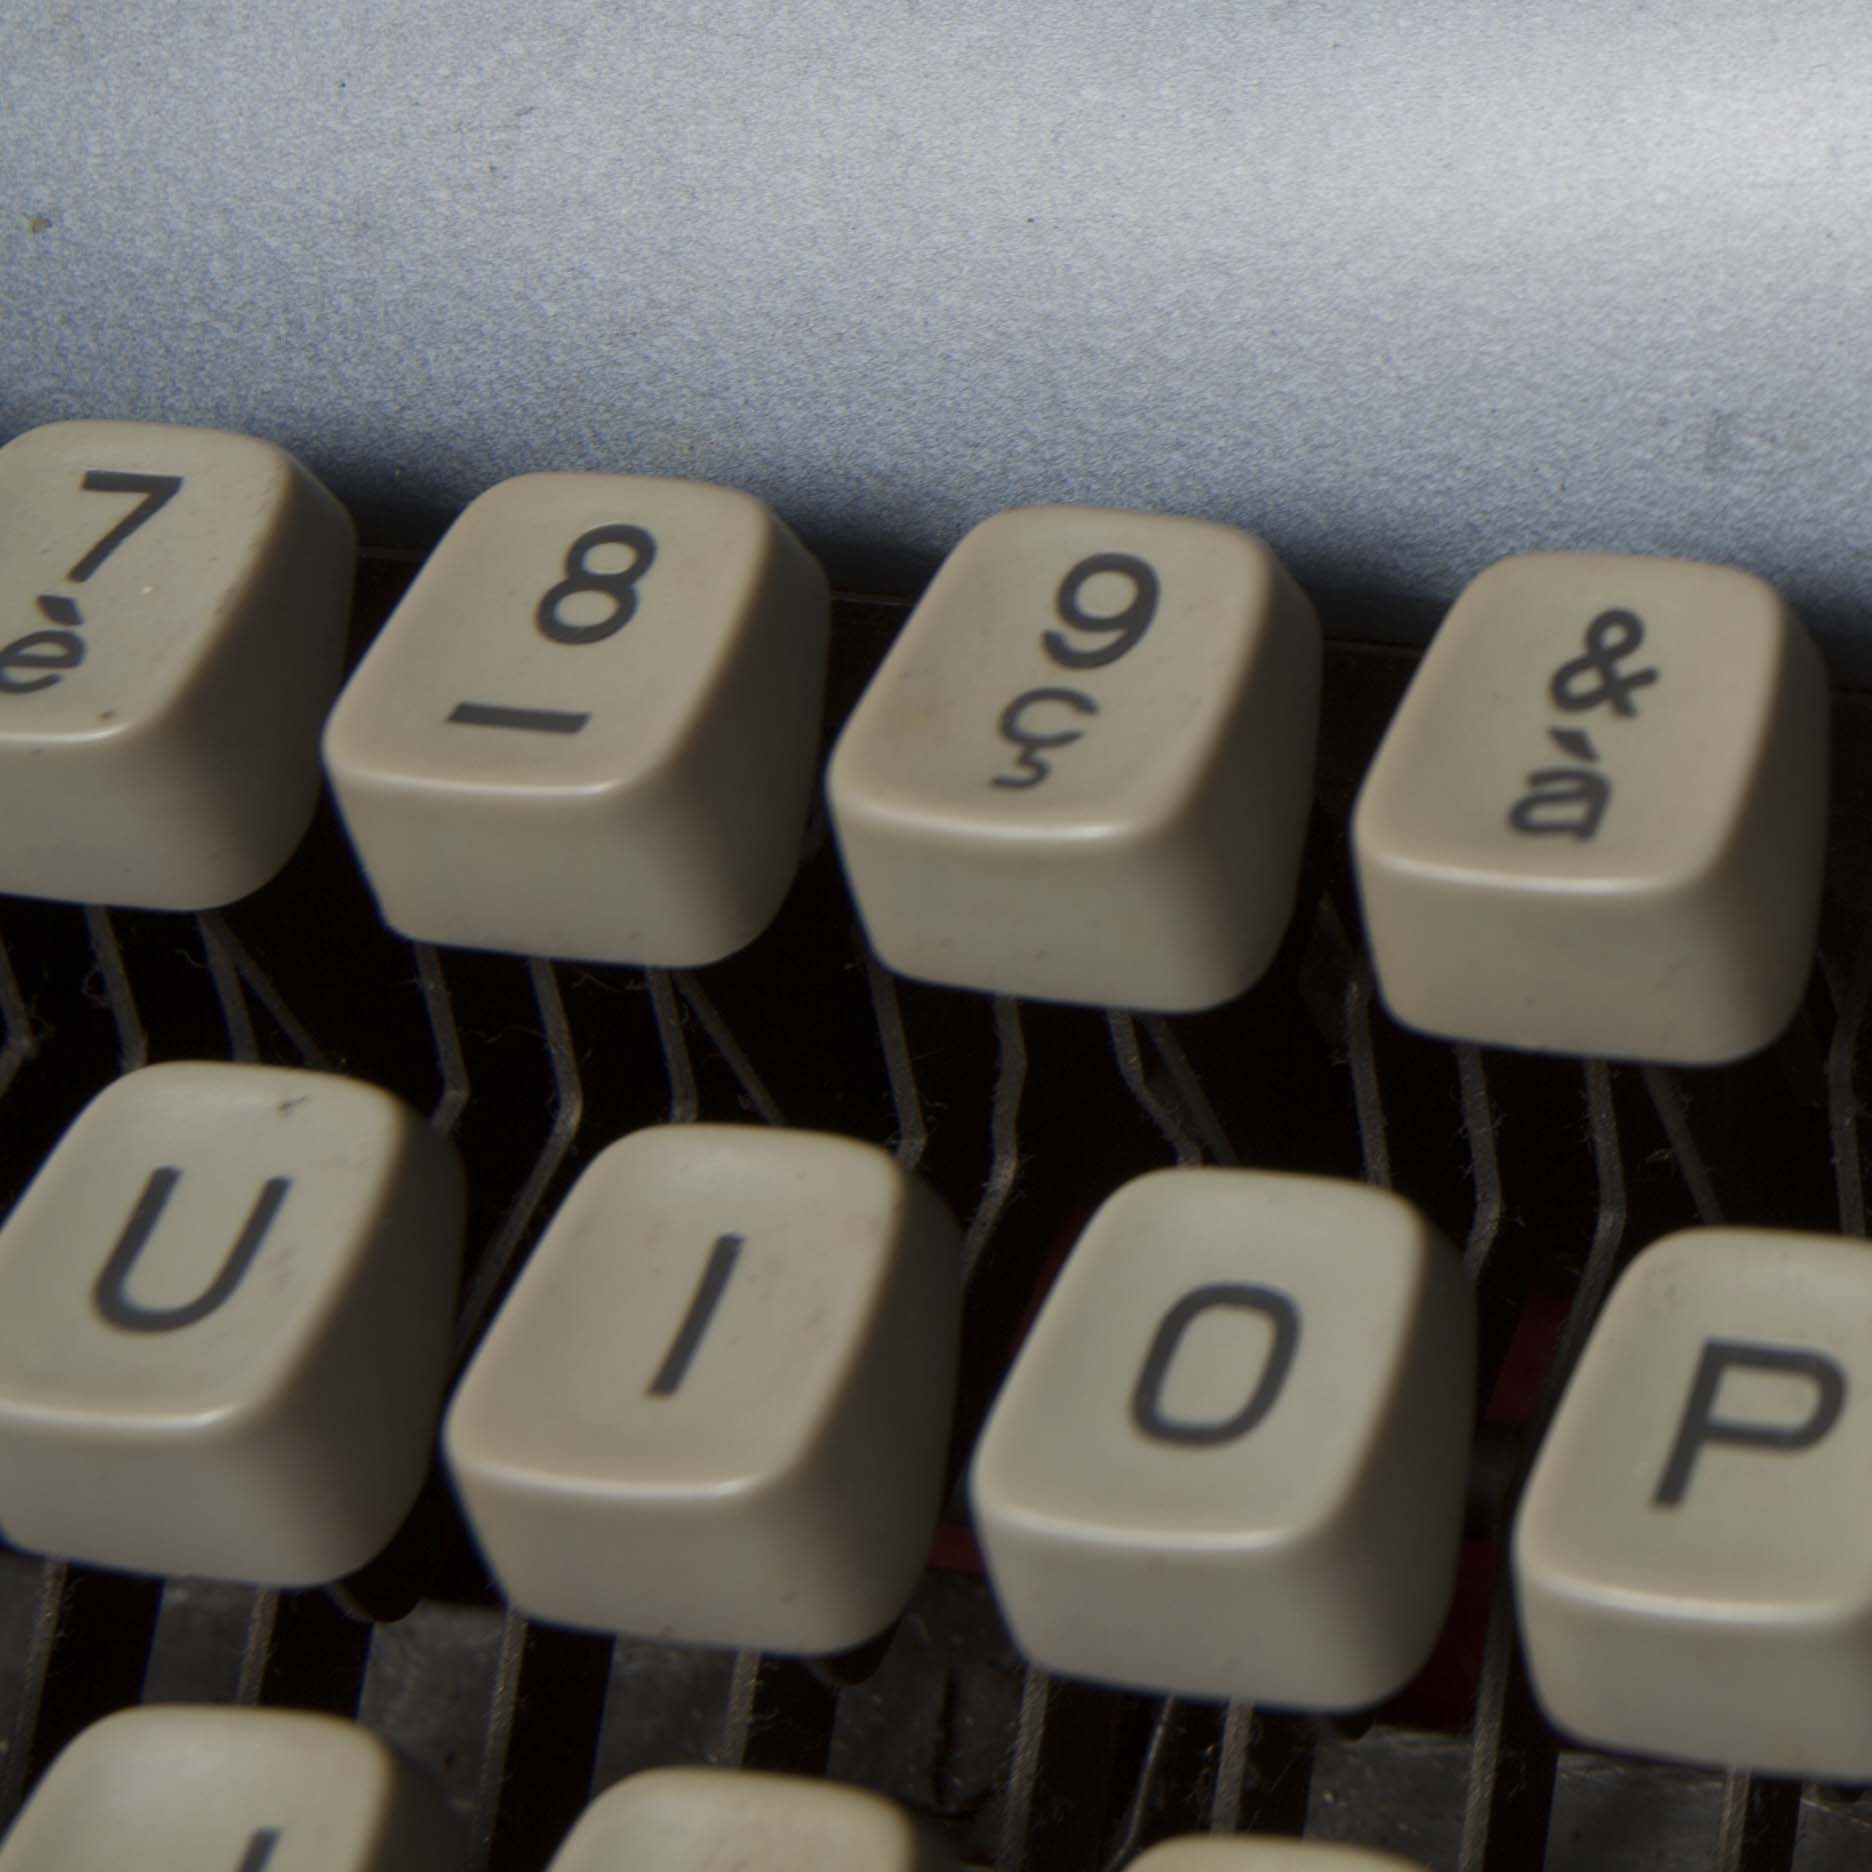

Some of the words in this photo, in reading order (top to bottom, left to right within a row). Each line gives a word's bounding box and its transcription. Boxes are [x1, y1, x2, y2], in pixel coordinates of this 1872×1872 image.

[68, 470, 184, 584] 7
[535, 522, 658, 646] 8
[1041, 551, 1160, 670] 9
[91, 1165, 294, 1334] U
[644, 1232, 747, 1399] I
[1128, 1282, 1302, 1450] O
[1649, 1336, 1849, 1510] P
